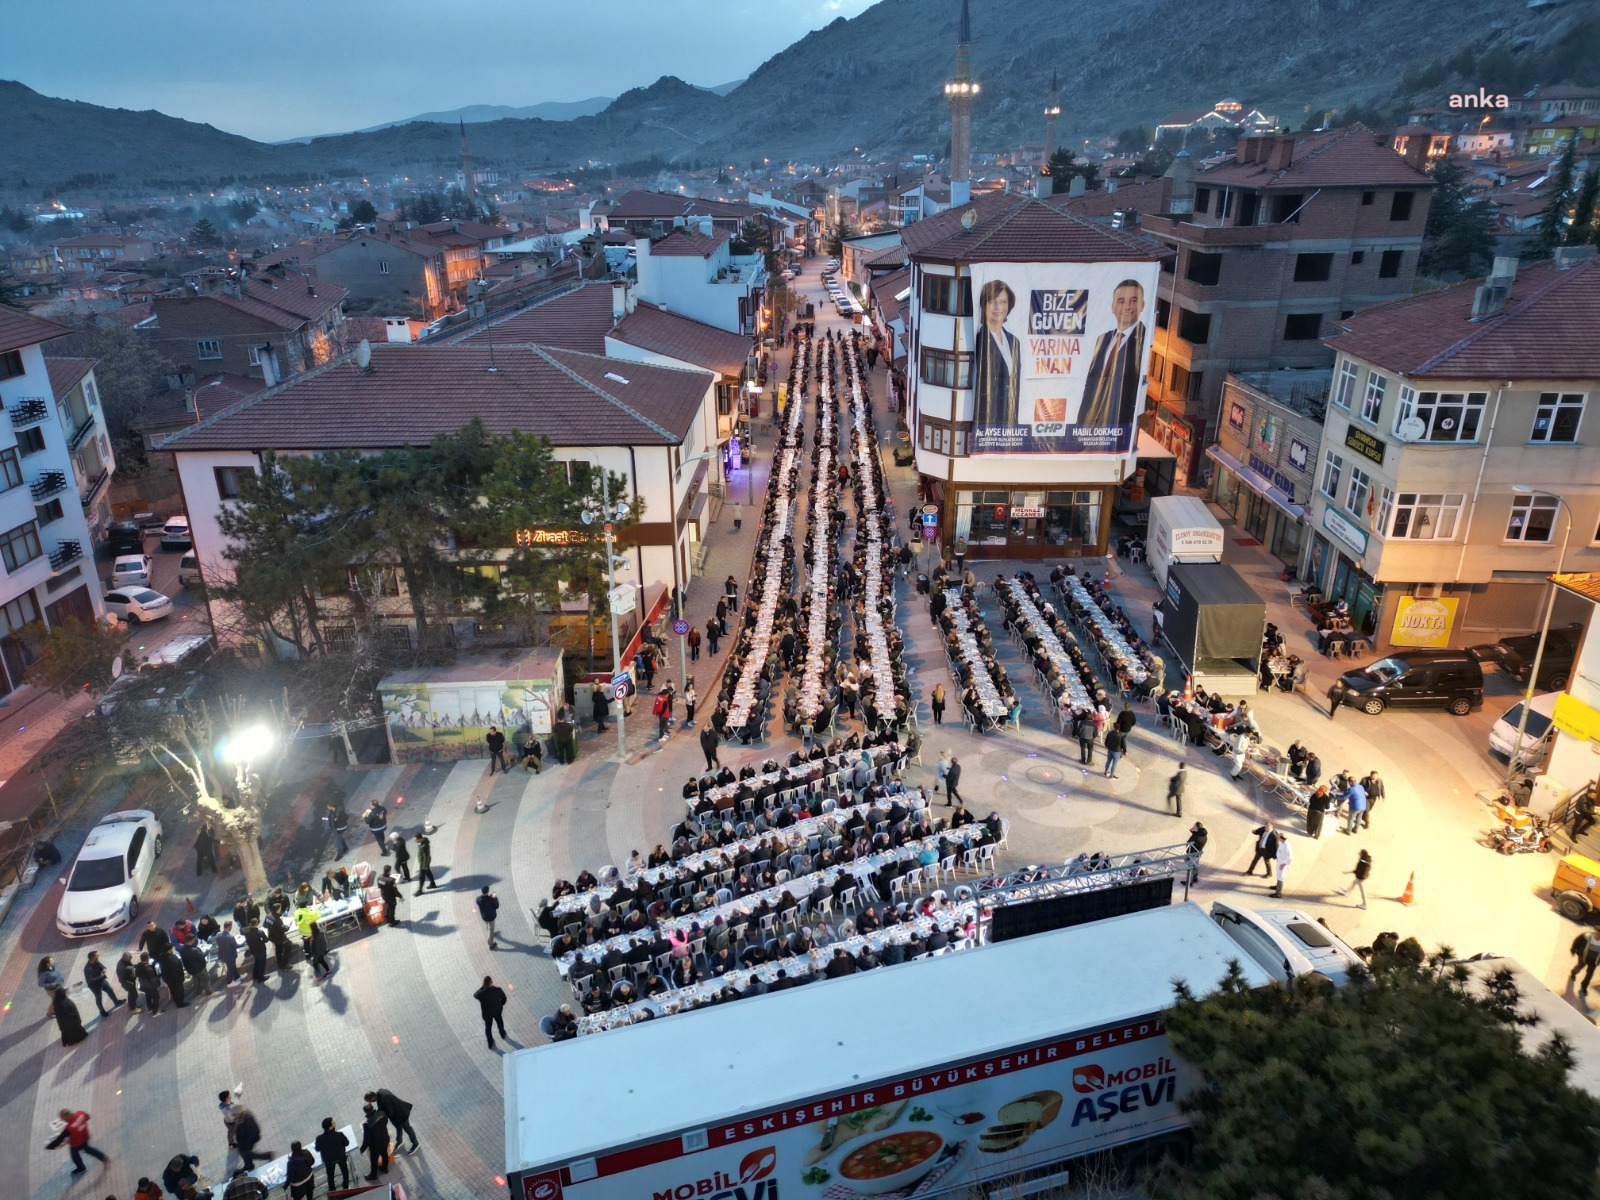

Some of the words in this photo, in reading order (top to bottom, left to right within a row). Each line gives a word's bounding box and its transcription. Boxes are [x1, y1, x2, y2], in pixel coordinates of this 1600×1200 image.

[1042, 293, 1075, 311] BİZE
[1032, 312, 1084, 330] GÜVEN
[1029, 338, 1081, 355] YARINA
[1035, 357, 1072, 374] İNAN
[1034, 423, 1063, 434] CHP
[533, 530, 568, 543] Ziraat
[1401, 615, 1446, 630] NOKTA
[1107, 1056, 1177, 1088] MOBİL
[725, 1090, 875, 1140] ESKİŞEHİR
[894, 1046, 1058, 1097] BÜYÜKŞEHİR
[1071, 1075, 1176, 1128] AŞEVİ
[652, 1171, 738, 1200] MOBİL
